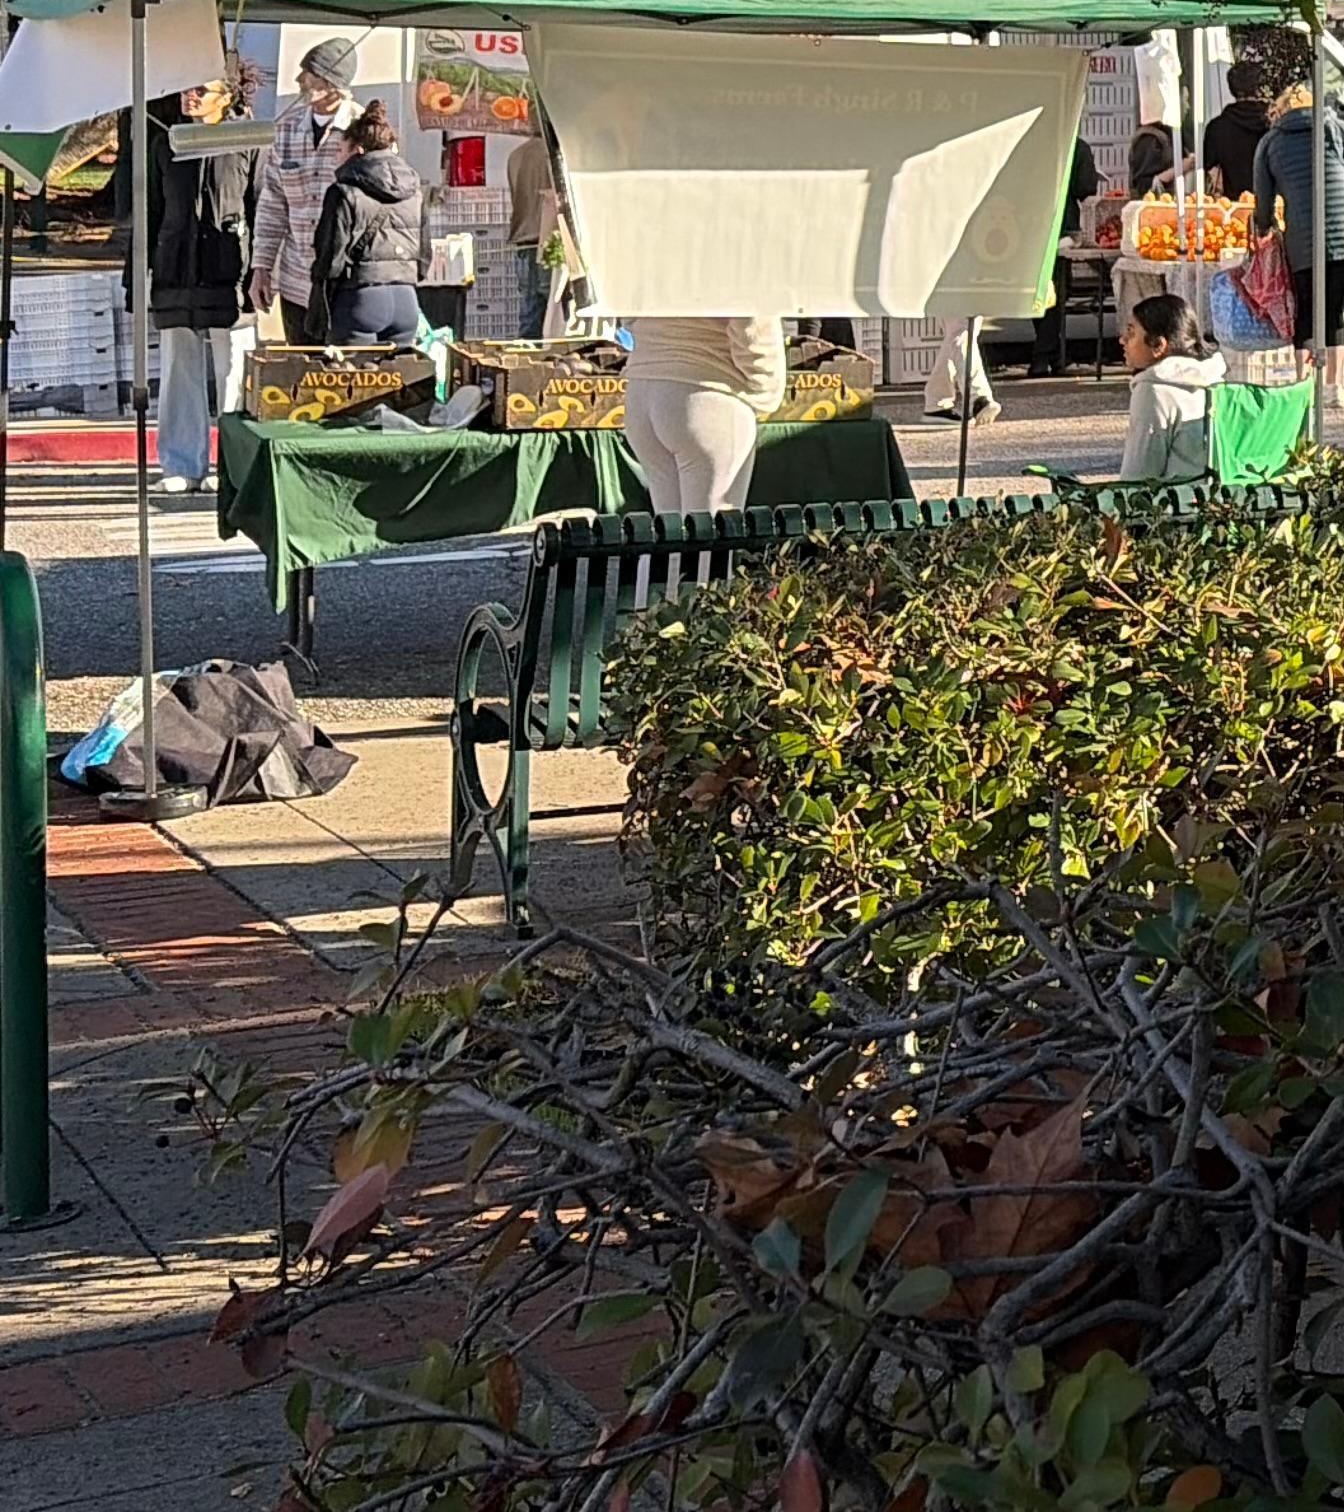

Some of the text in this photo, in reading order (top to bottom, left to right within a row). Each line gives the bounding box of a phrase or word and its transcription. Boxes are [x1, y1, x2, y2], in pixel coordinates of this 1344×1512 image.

[474, 33, 522, 55] US
[301, 371, 403, 387] AVOCADOS
[544, 378, 629, 394] AVOCADO
